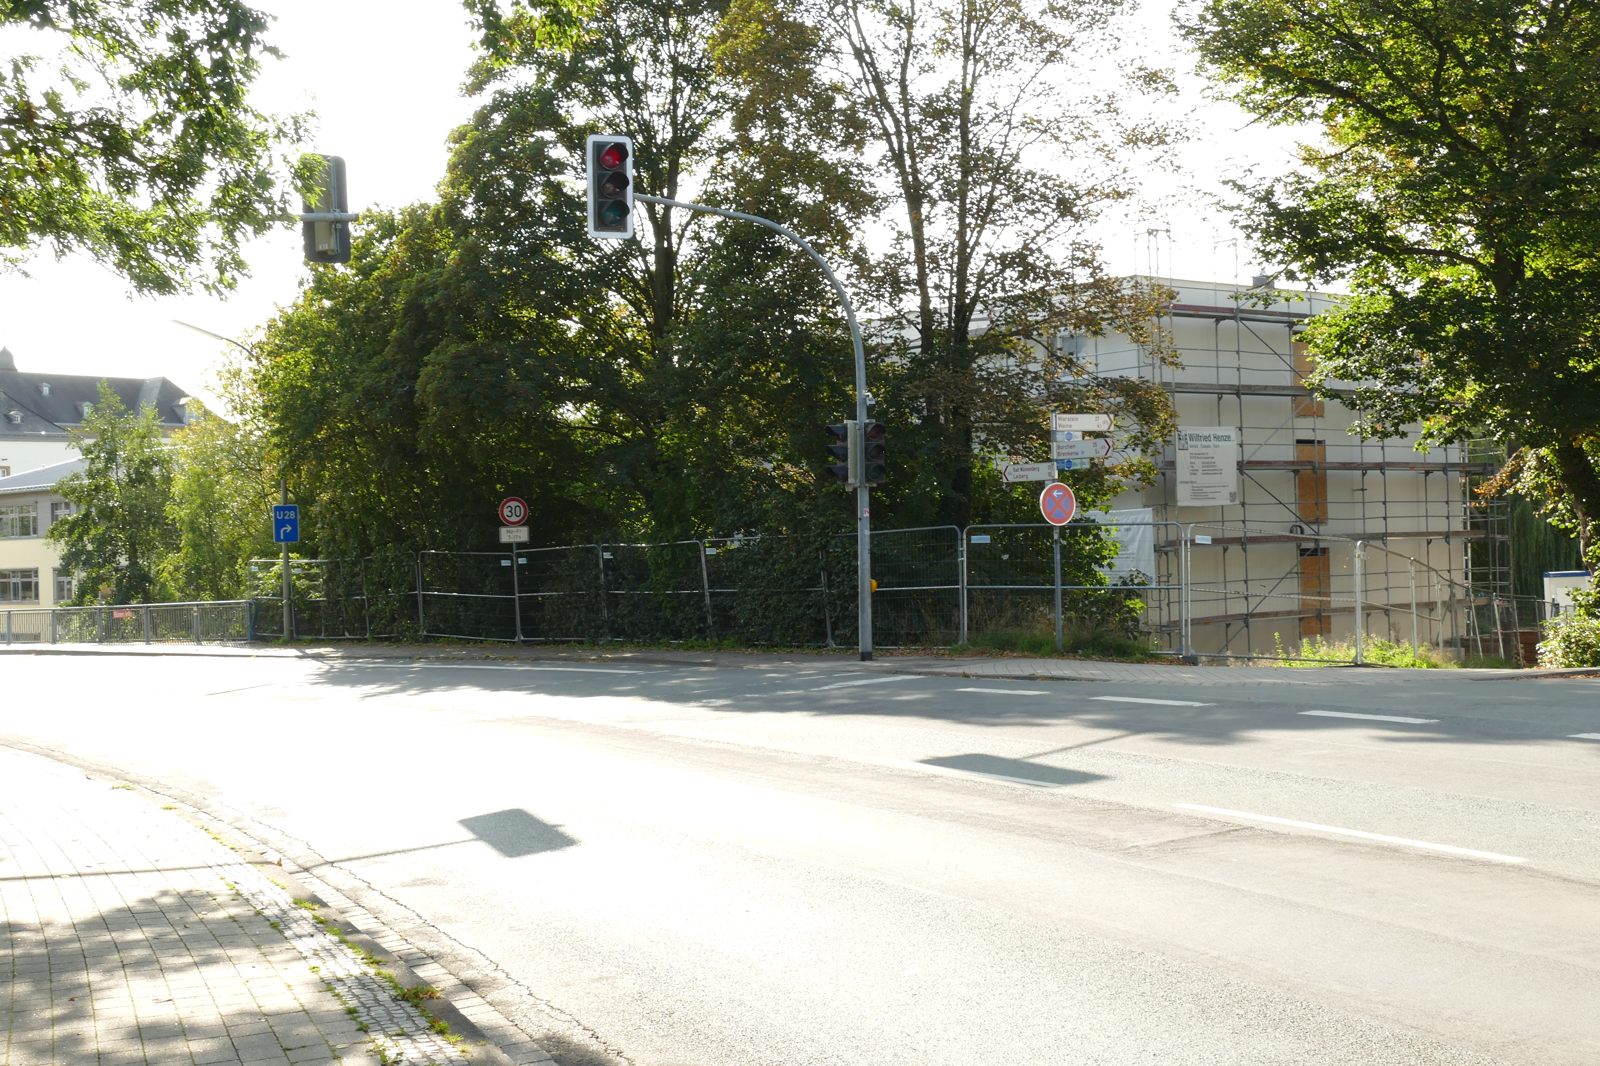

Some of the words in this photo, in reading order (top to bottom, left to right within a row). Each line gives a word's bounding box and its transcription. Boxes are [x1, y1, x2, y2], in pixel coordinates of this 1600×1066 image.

[1188, 433, 1211, 442] Wilfried
[1212, 433, 1231, 442] Henze
[506, 505, 522, 518] 30
